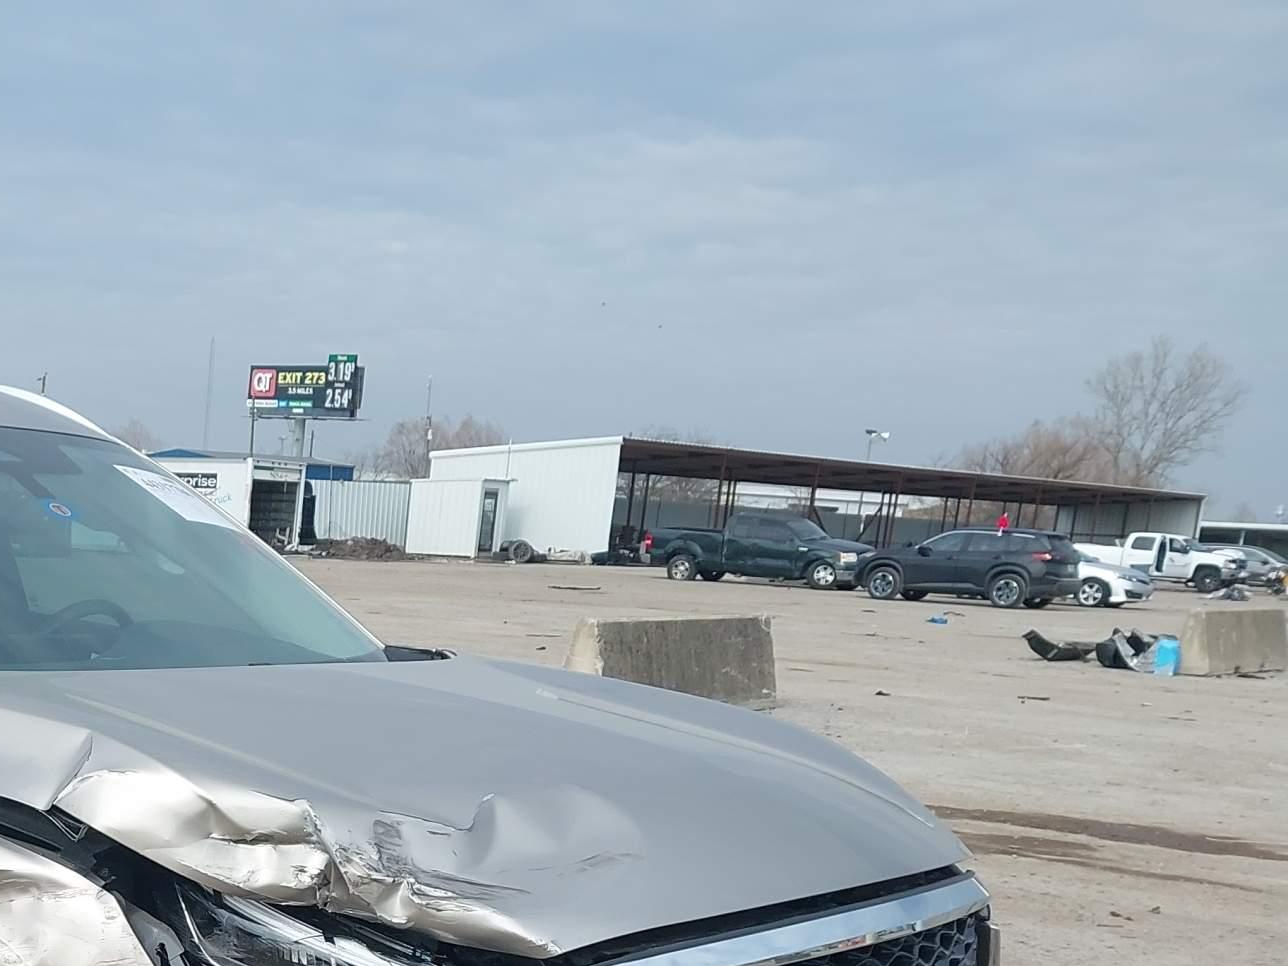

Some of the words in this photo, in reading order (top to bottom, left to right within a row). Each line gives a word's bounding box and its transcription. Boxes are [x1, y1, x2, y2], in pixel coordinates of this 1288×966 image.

[253, 372, 273, 392] QT
[278, 372, 303, 384] EXIT
[304, 372, 326, 384] 273
